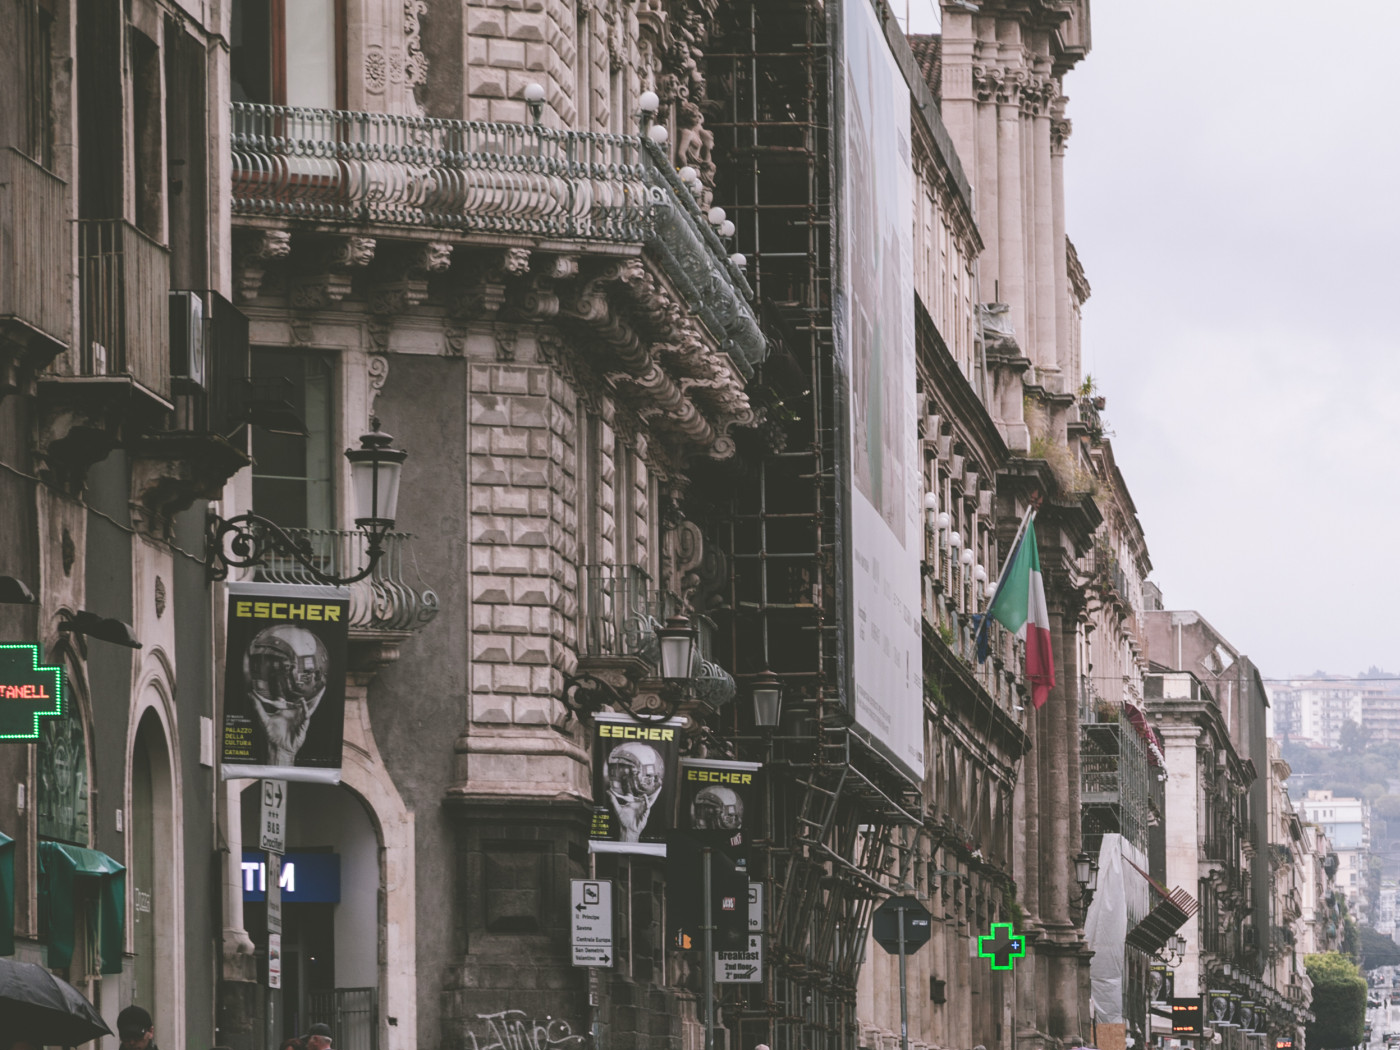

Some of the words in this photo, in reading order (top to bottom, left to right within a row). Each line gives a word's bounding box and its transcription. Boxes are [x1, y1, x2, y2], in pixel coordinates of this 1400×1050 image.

[236, 601, 341, 622] ESCHER
[599, 725, 674, 742] ESCHER
[687, 770, 752, 785] ESCHER
[718, 951, 759, 961] Breakfast
